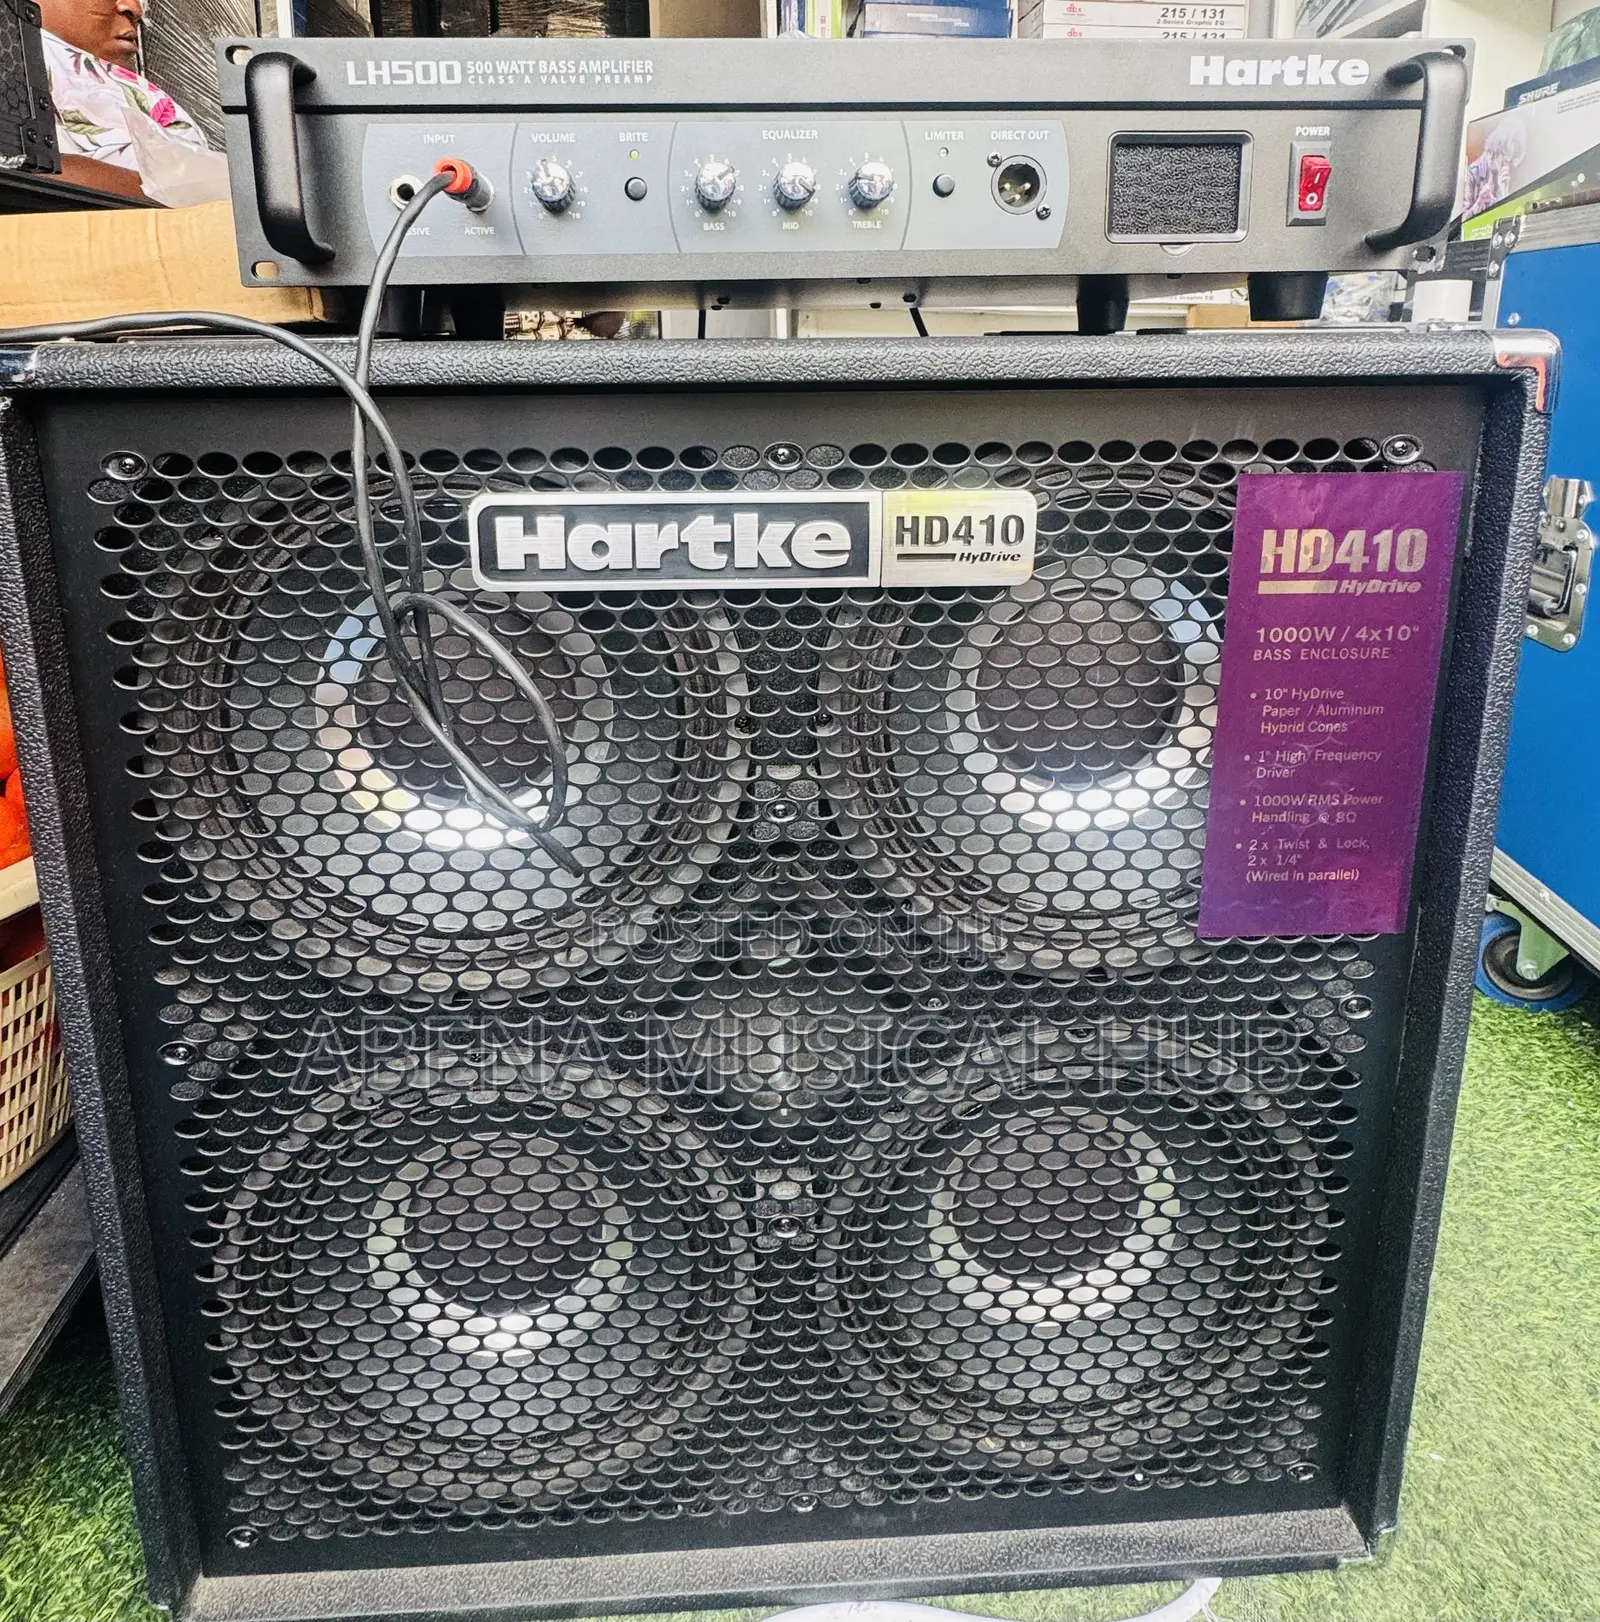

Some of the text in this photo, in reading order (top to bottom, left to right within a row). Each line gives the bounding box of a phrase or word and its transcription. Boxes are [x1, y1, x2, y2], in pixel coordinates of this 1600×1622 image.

[1160, 7, 1225, 19] 215 / 131
[346, 60, 654, 86] LH500 500 WATT BASS AMPLIFIER
[1189, 54, 1370, 86] Hartke
[468, 75, 653, 85] CLASS A VALVE PREAMP
[1518, 81, 1561, 105] SHURE
[531, 132, 576, 143] VOLUME
[619, 132, 648, 142] BRITE
[762, 130, 818, 140] EQUALIZER
[925, 130, 964, 140] LIMITER
[991, 130, 1049, 140] DIRECT OUT
[1295, 126, 1331, 136] POWER
[423, 134, 456, 144] INPUT
[464, 226, 495, 235] ACTIVE
[703, 222, 725, 231] BASS
[782, 222, 799, 230] MID
[852, 220, 882, 229] TREBLE
[495, 512, 1025, 571] Hartke HD410
[1260, 528, 1428, 574] HD410
[959, 551, 1022, 565] HyDrive
[1339, 579, 1422, 597] HyDrive
[1256, 626, 1336, 643] 1000W
[1341, 625, 1349, 642] /
[1253, 647, 1390, 661] BASS ENCLOSURE
[1265, 687, 1345, 703] 10" HyDrive
[1262, 705, 1300, 718] Paper
[1261, 721, 1348, 736] Hybrid Cones
[1276, 750, 1306, 764] High
[1315, 750, 1382, 764] Frequency
[1256, 768, 1296, 779] Driver
[1254, 793, 1383, 807] 1000W RMS Power
[1252, 811, 1311, 824] Handling
[1319, 811, 1330, 824] @
[1249, 839, 1257, 851] 2
[1262, 842, 1268, 850] x
[1277, 838, 1310, 850] Twist
[1318, 838, 1328, 849] &
[1248, 855, 1256, 866] 2
[1260, 857, 1267, 866] x
[1246, 868, 1360, 883] (Wired in parallel)
